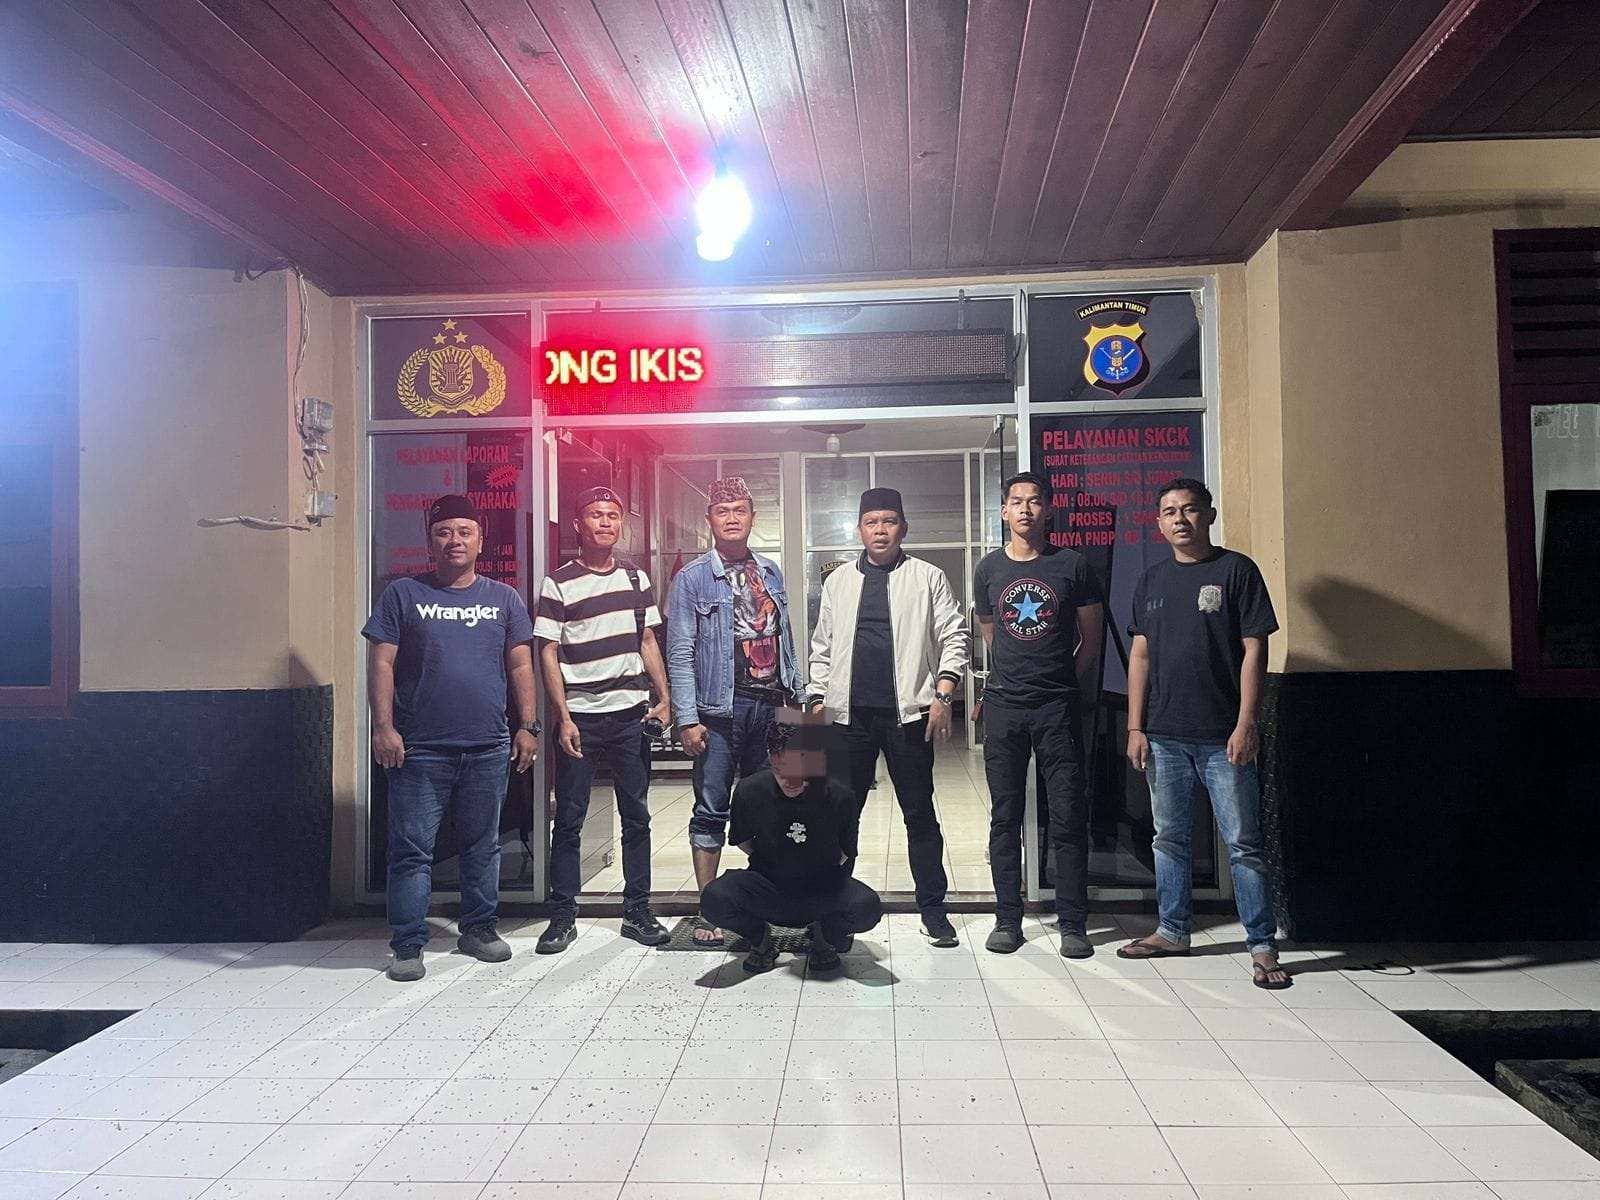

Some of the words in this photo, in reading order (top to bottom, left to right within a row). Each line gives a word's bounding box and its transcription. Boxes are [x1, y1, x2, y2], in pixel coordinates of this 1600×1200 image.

[1079, 301, 1123, 318] KALIMANTAN
[1124, 302, 1147, 315] TIMUR
[630, 347, 704, 383] IKIS
[1043, 428, 1140, 450] PELAYANAN
[1145, 425, 1190, 447] SKCK
[1051, 473, 1078, 488] HARI
[1052, 493, 1069, 508] AM
[1077, 492, 1107, 507] 08.00
[1069, 511, 1113, 527] PROSES
[1050, 531, 1082, 547] BIAYA
[1086, 530, 1116, 546] PNBP
[1005, 583, 1051, 604] CONVERSE
[416, 603, 500, 628] Wrangler
[1010, 621, 1024, 635] ALL
[1025, 620, 1048, 635] STAR
